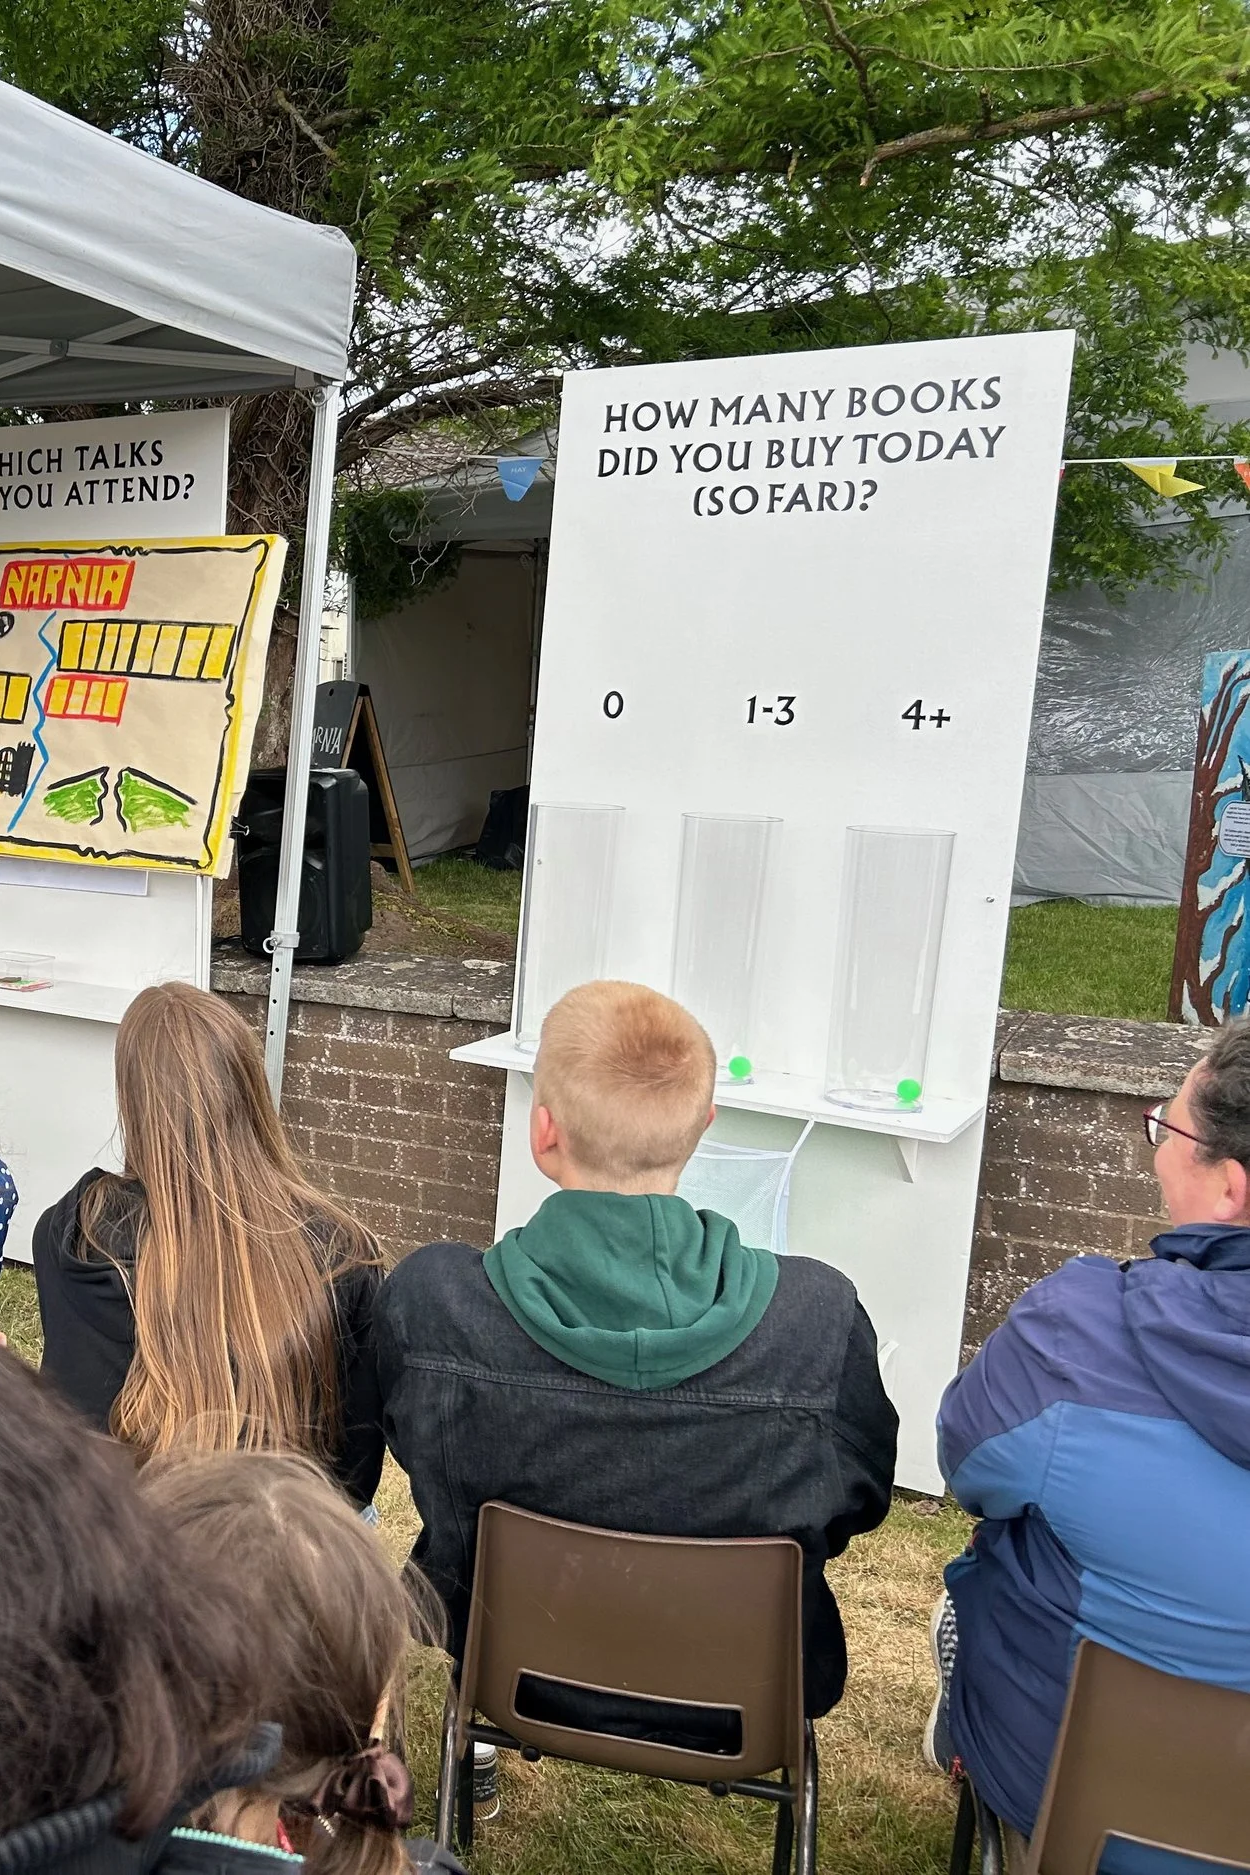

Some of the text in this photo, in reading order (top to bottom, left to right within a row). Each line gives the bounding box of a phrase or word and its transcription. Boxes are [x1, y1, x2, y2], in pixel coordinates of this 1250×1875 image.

[604, 376, 1002, 433] HOW MANY BOOKS
[73, 439, 164, 473] TALKS
[598, 425, 1007, 478] DID YOU BUY TODAY
[63, 473, 196, 507] ATTEND?
[4, 564, 129, 606] NARNIA
[603, 691, 624, 719] 0
[746, 695, 796, 726] 1-3
[901, 699, 952, 730] 4+
